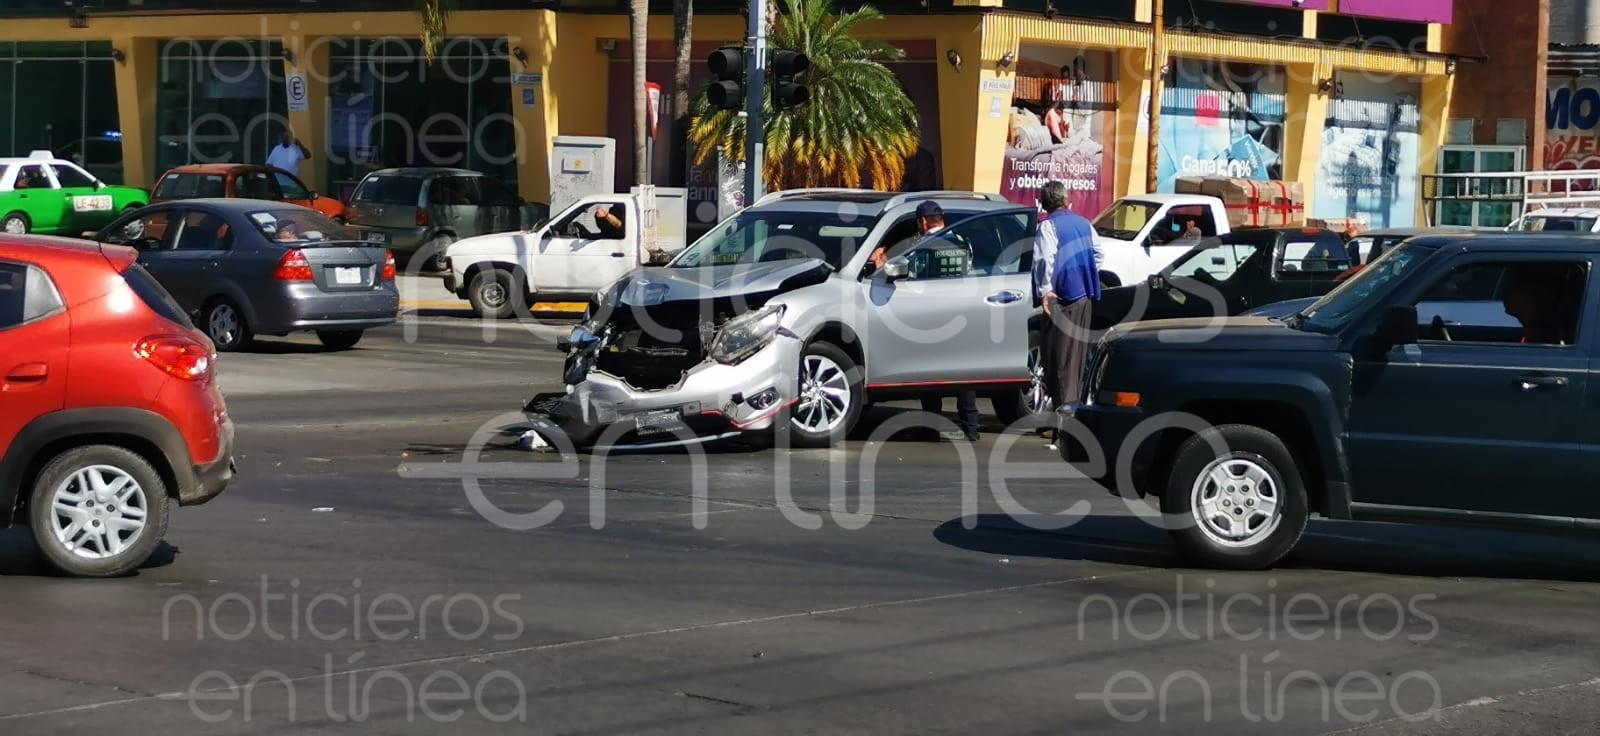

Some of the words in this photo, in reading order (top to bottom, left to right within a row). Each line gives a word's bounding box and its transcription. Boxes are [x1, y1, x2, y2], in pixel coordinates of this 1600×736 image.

[293, 81, 302, 96] E
[1010, 158, 1061, 172] Transforma
[1063, 161, 1098, 177] hogares
[1182, 154, 1215, 176] Gana
[1010, 177, 1016, 190] y
